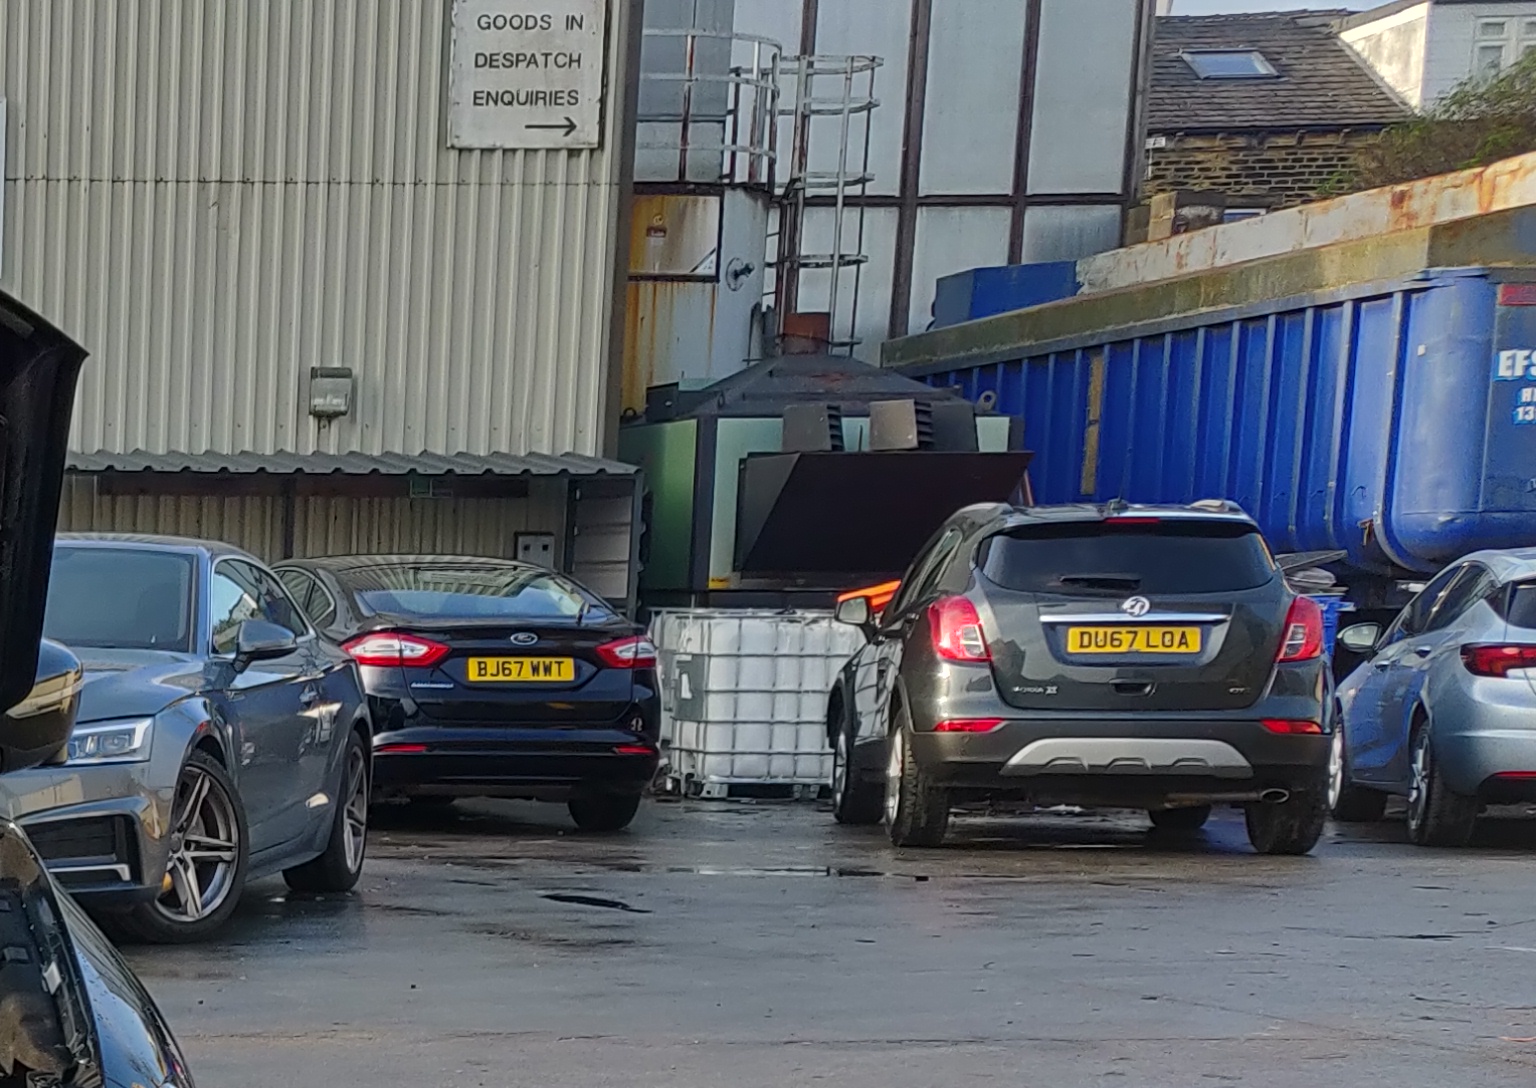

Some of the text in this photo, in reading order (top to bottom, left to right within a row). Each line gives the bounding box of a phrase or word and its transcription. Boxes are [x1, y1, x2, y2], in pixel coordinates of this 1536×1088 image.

[477, 14, 584, 31] GOODS IN
[474, 52, 581, 69] DESPATCH
[472, 90, 579, 107] ENQUIRIES
[1079, 631, 1189, 649] DU67 LOA
[477, 661, 564, 678] BJ67 WWT
